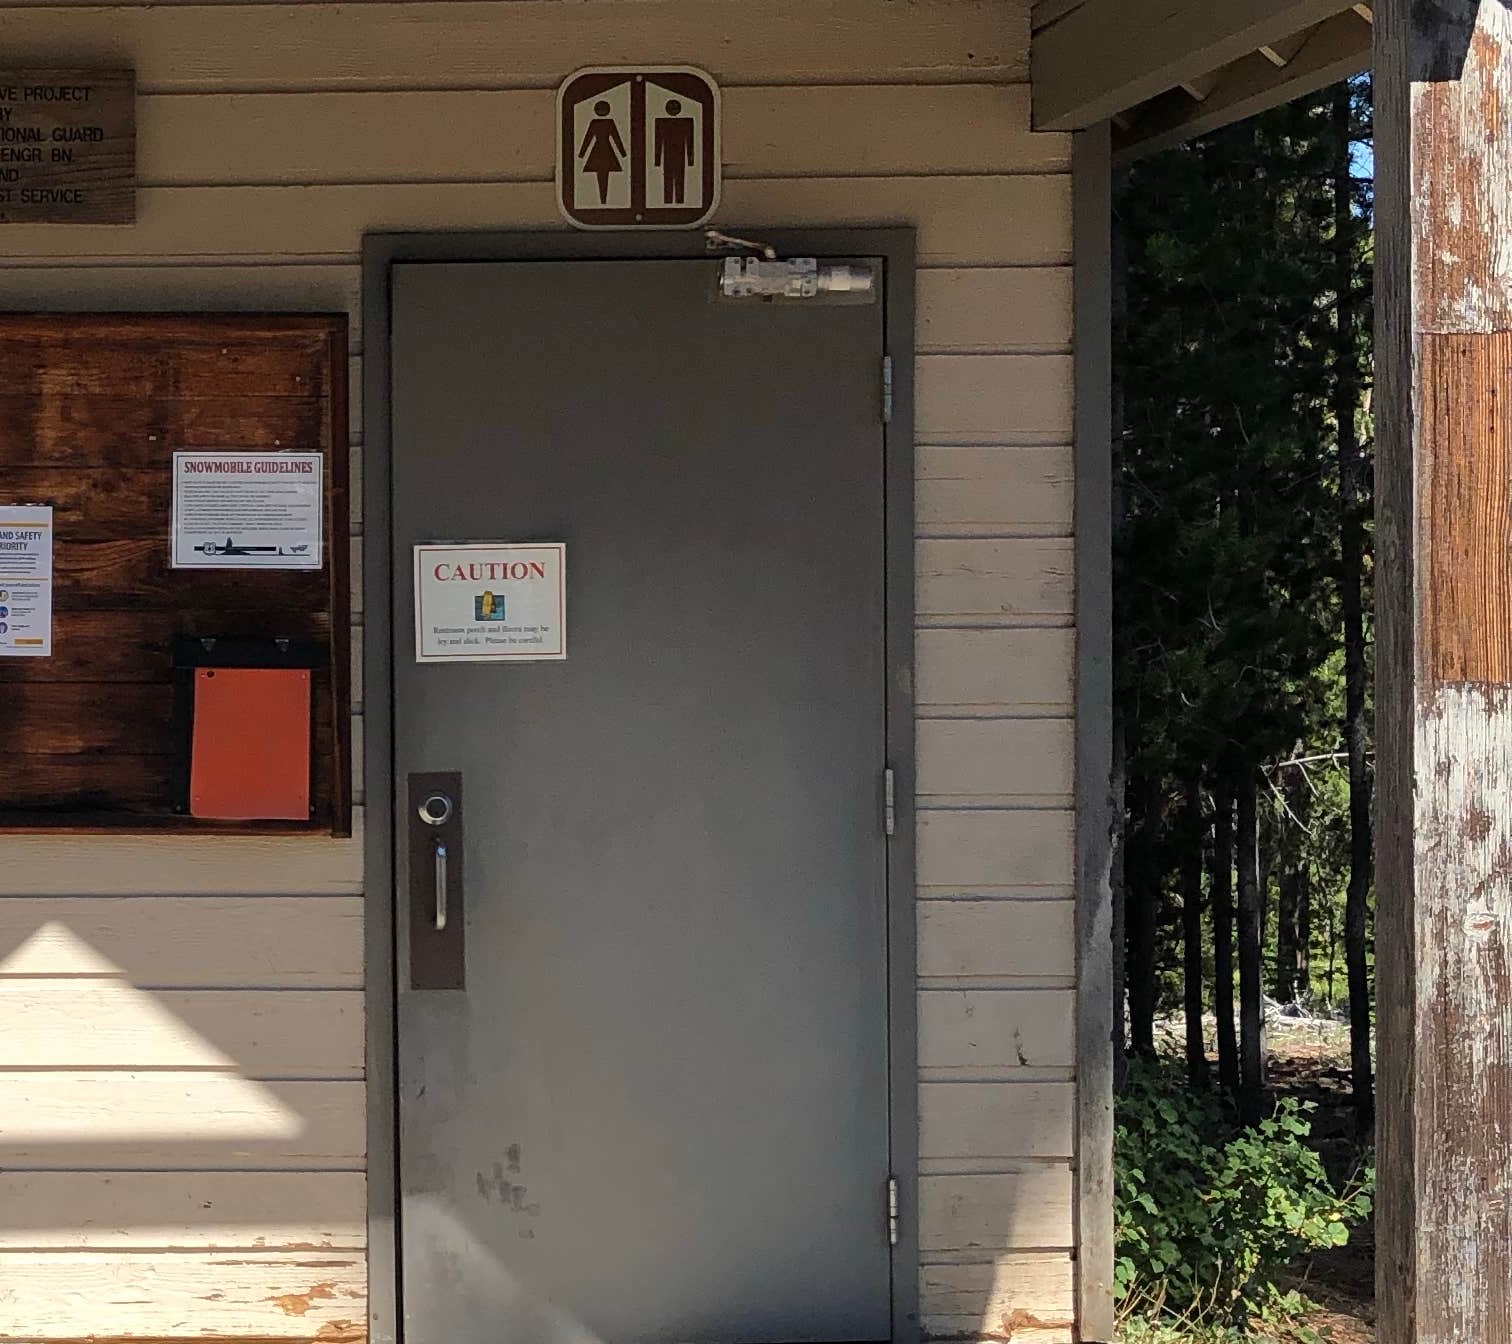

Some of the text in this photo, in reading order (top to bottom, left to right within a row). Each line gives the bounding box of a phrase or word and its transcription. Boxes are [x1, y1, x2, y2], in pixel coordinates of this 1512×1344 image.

[24, 86, 93, 102] PROJECT
[52, 127, 104, 142] GUARD
[20, 188, 83, 203] SERVICE
[184, 461, 313, 474] SNOWMOBILE GUIDELINES
[15, 531, 42, 541] SAFETY
[434, 561, 547, 582] CAUTION
